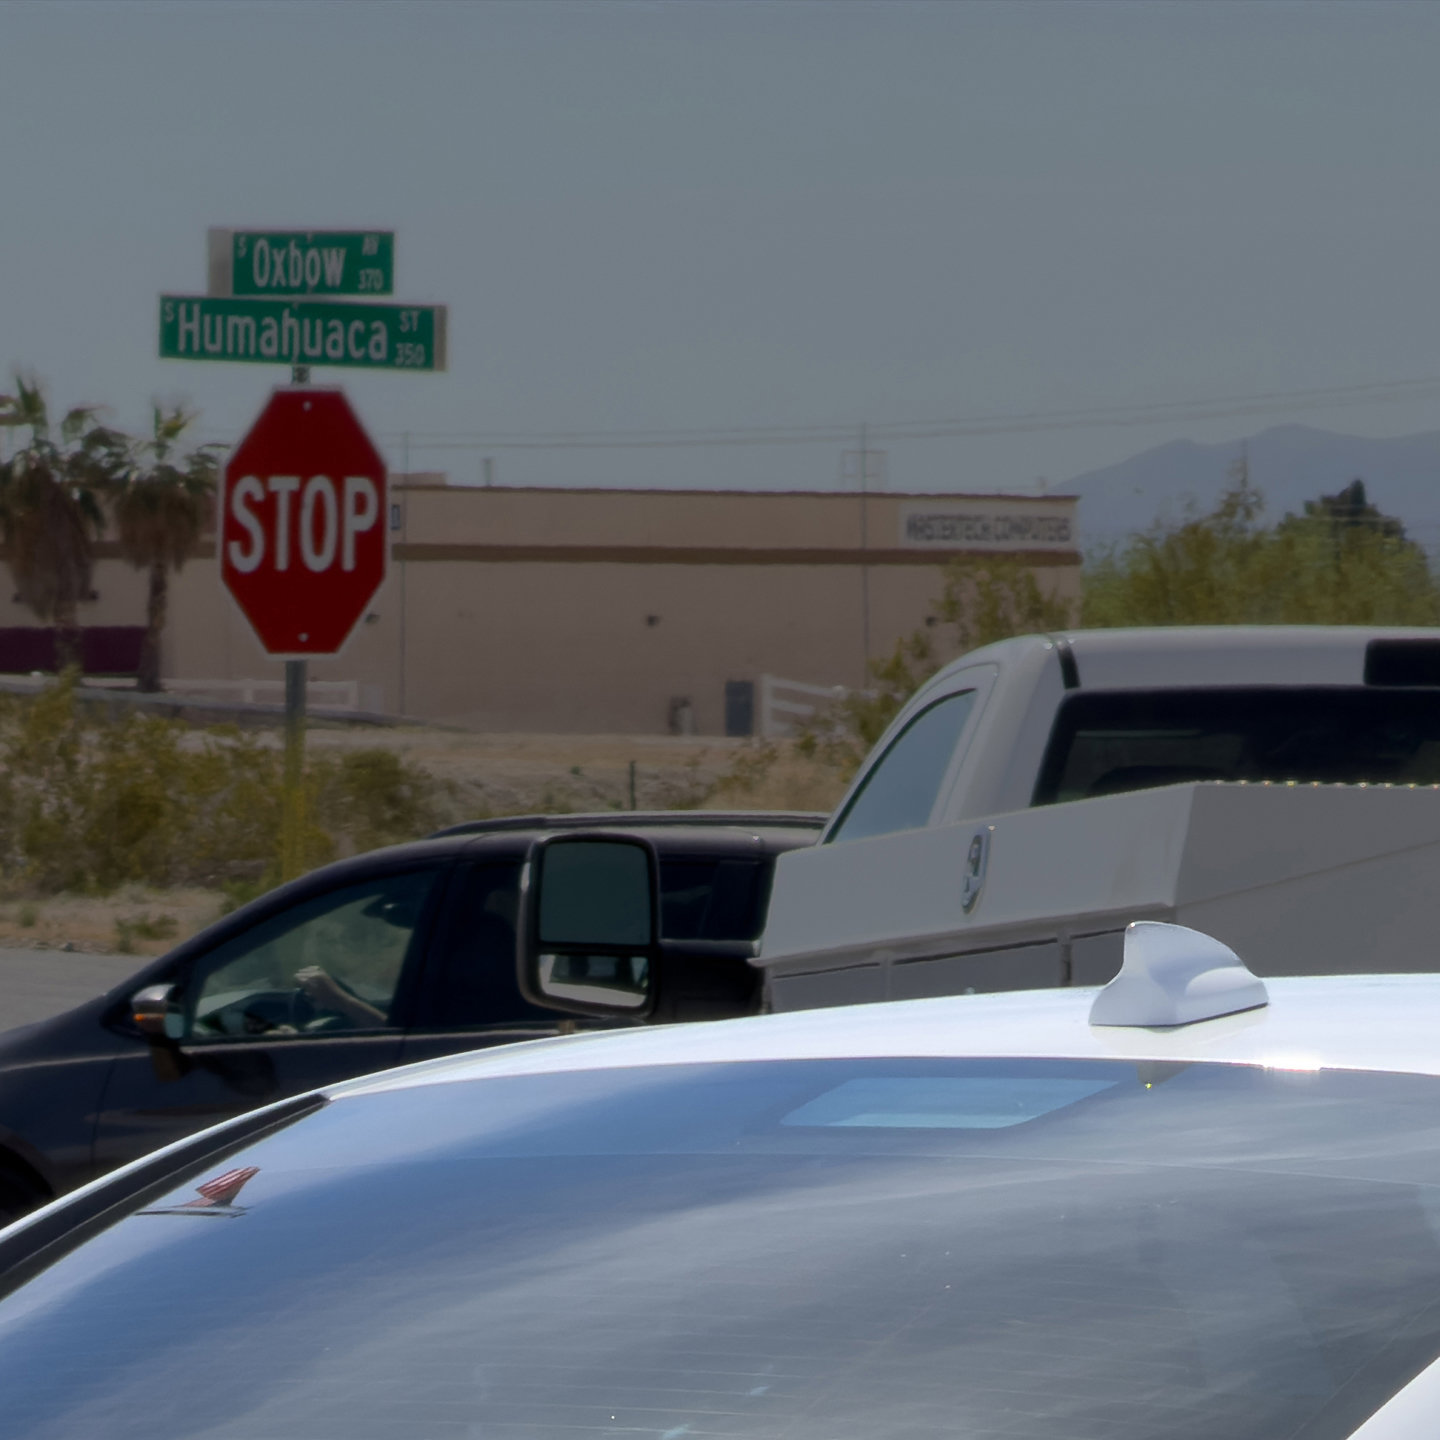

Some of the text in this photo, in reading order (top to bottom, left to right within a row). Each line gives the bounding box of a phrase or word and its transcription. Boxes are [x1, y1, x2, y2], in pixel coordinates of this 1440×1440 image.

[237, 237, 247, 258] S
[252, 238, 347, 288] Oxbow
[357, 268, 385, 291] 370
[164, 301, 421, 361] S Humahuaca ST
[394, 343, 426, 367] 350
[228, 475, 378, 574] STOP
